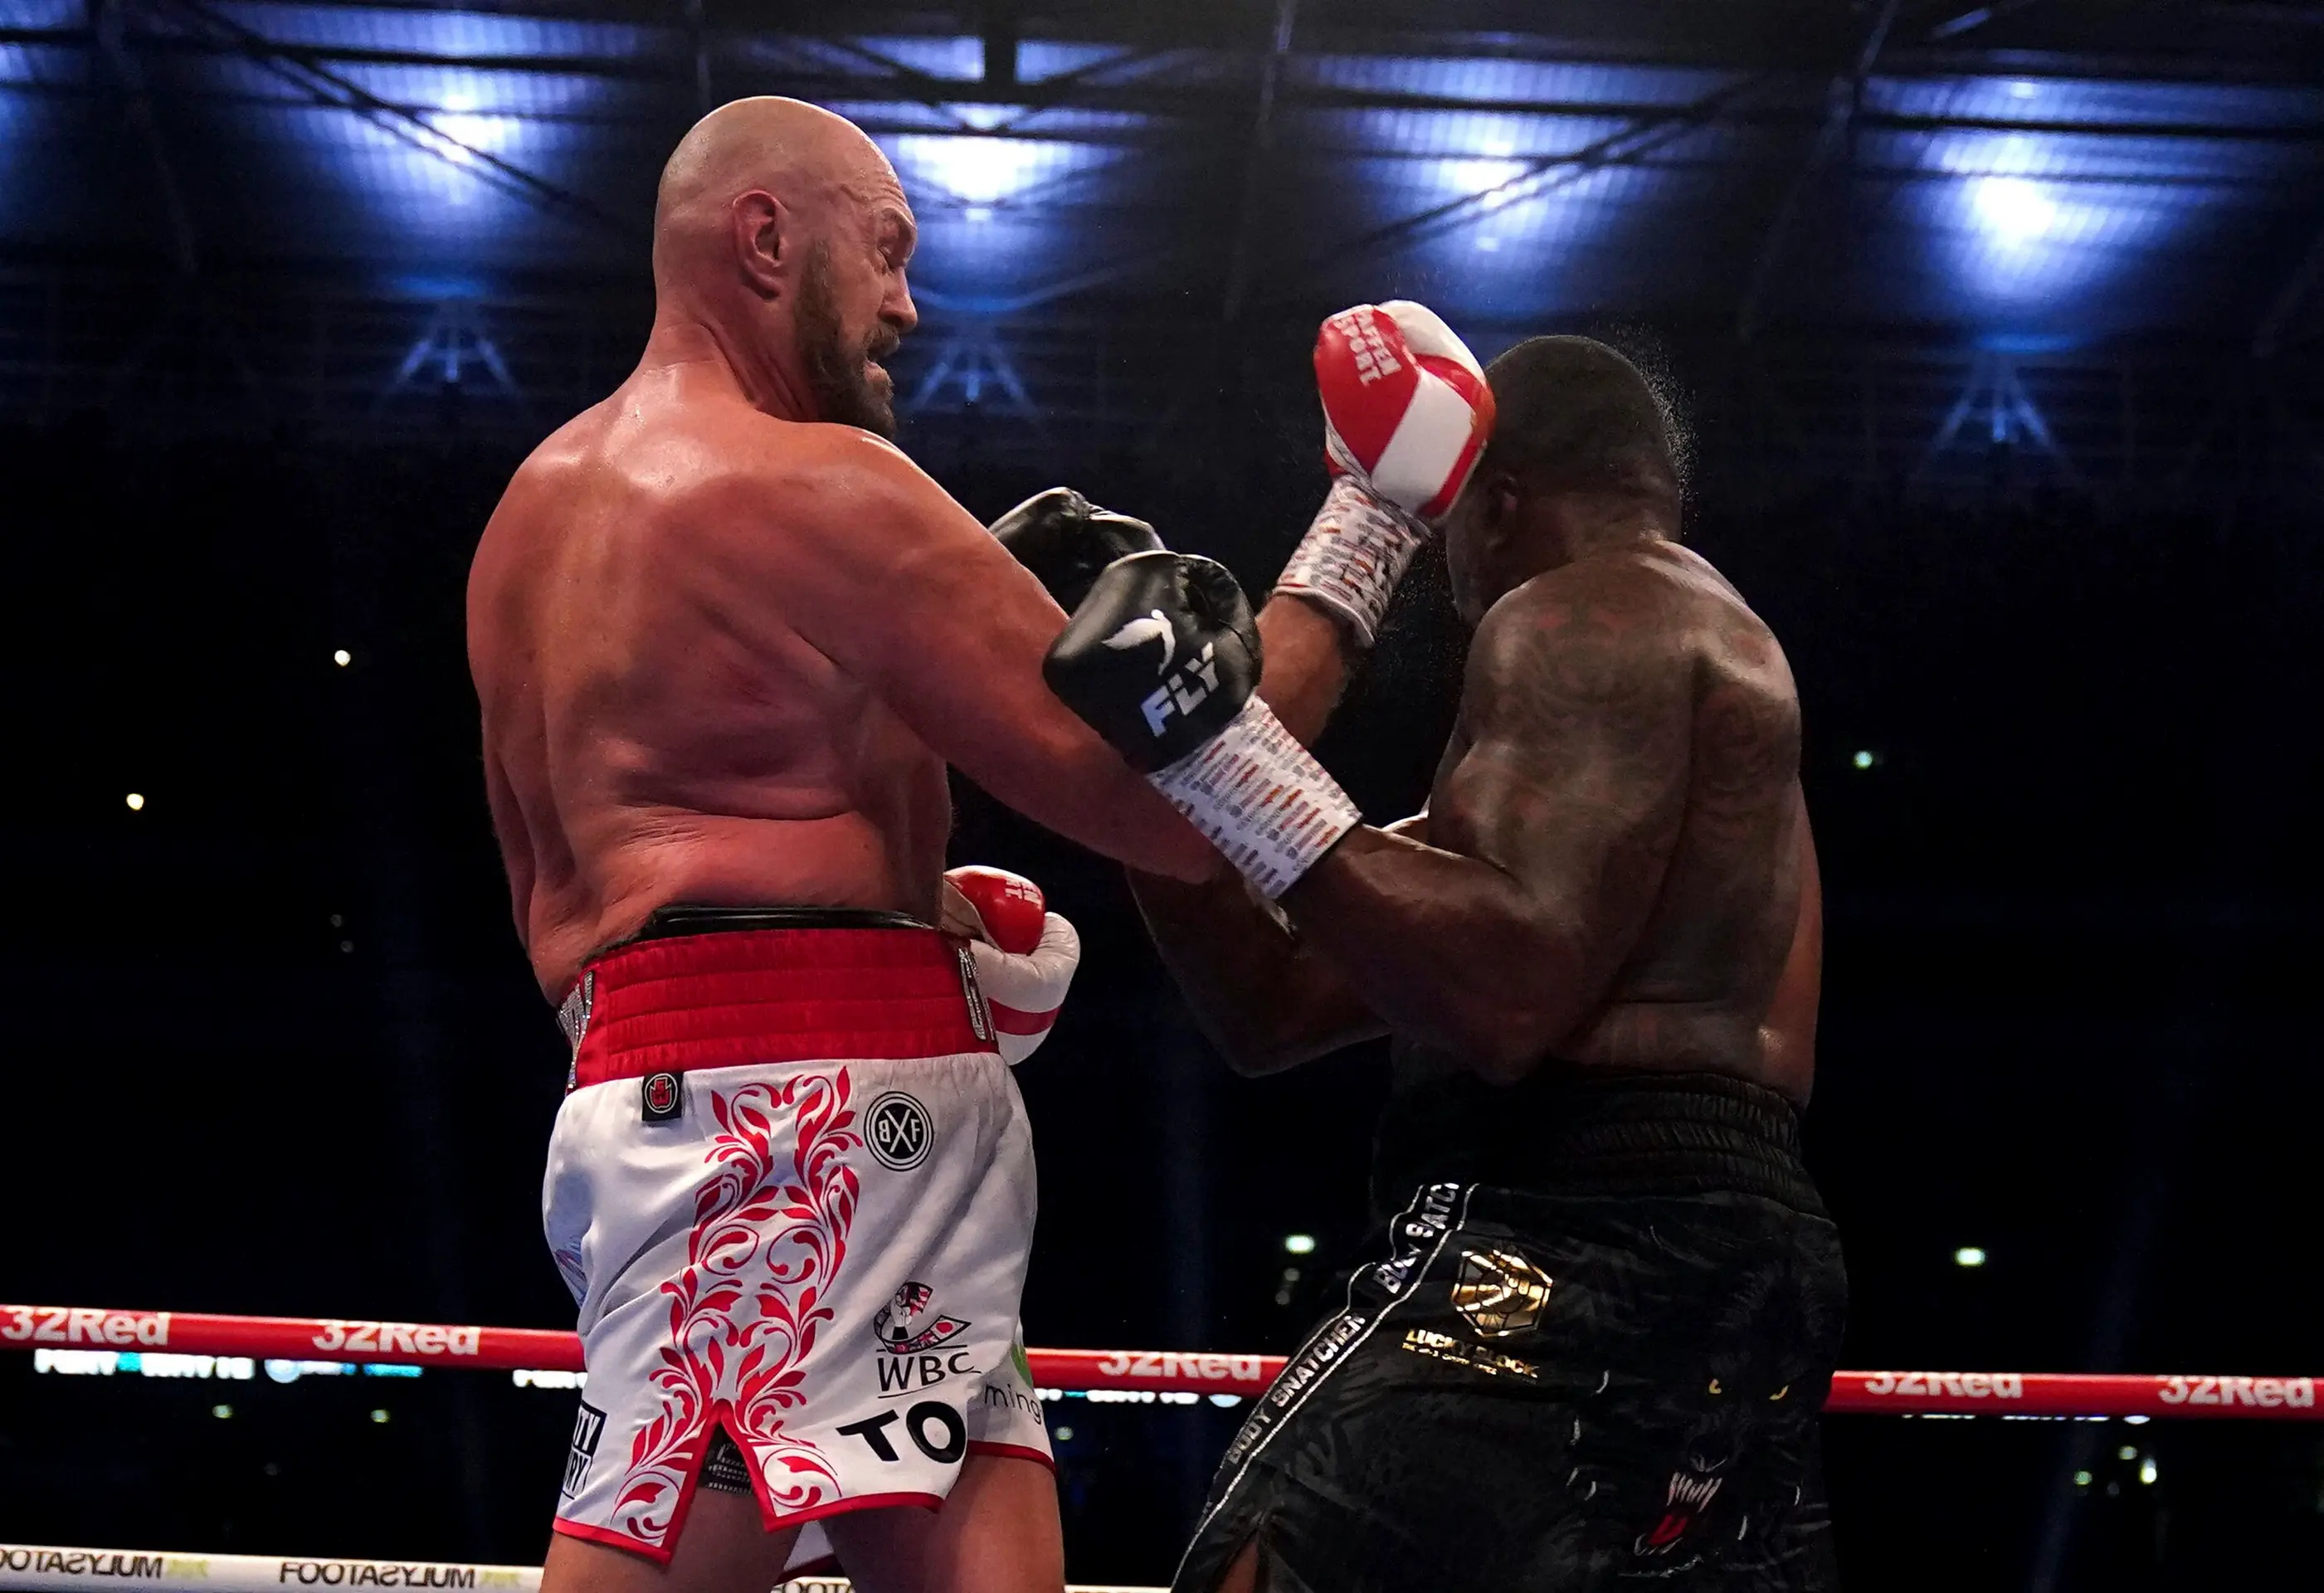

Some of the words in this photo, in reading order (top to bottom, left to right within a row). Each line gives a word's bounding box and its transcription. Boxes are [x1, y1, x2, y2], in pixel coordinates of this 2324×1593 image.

[1141, 641, 1220, 738] FLY
[879, 1108, 920, 1152] BXF
[2, 1305, 172, 1346] 32Red
[311, 1319, 482, 1356] 32Red
[878, 1352, 975, 1392] WBC
[1098, 1352, 1260, 1381] 32Red
[1865, 1371, 2024, 1399] 32Red
[1226, 1408, 1272, 1464] BODY
[1270, 1314, 1367, 1408] SNATCHER
[2159, 1375, 2315, 1408] 32Red
[279, 1561, 475, 1589] FOOTASYLUM
